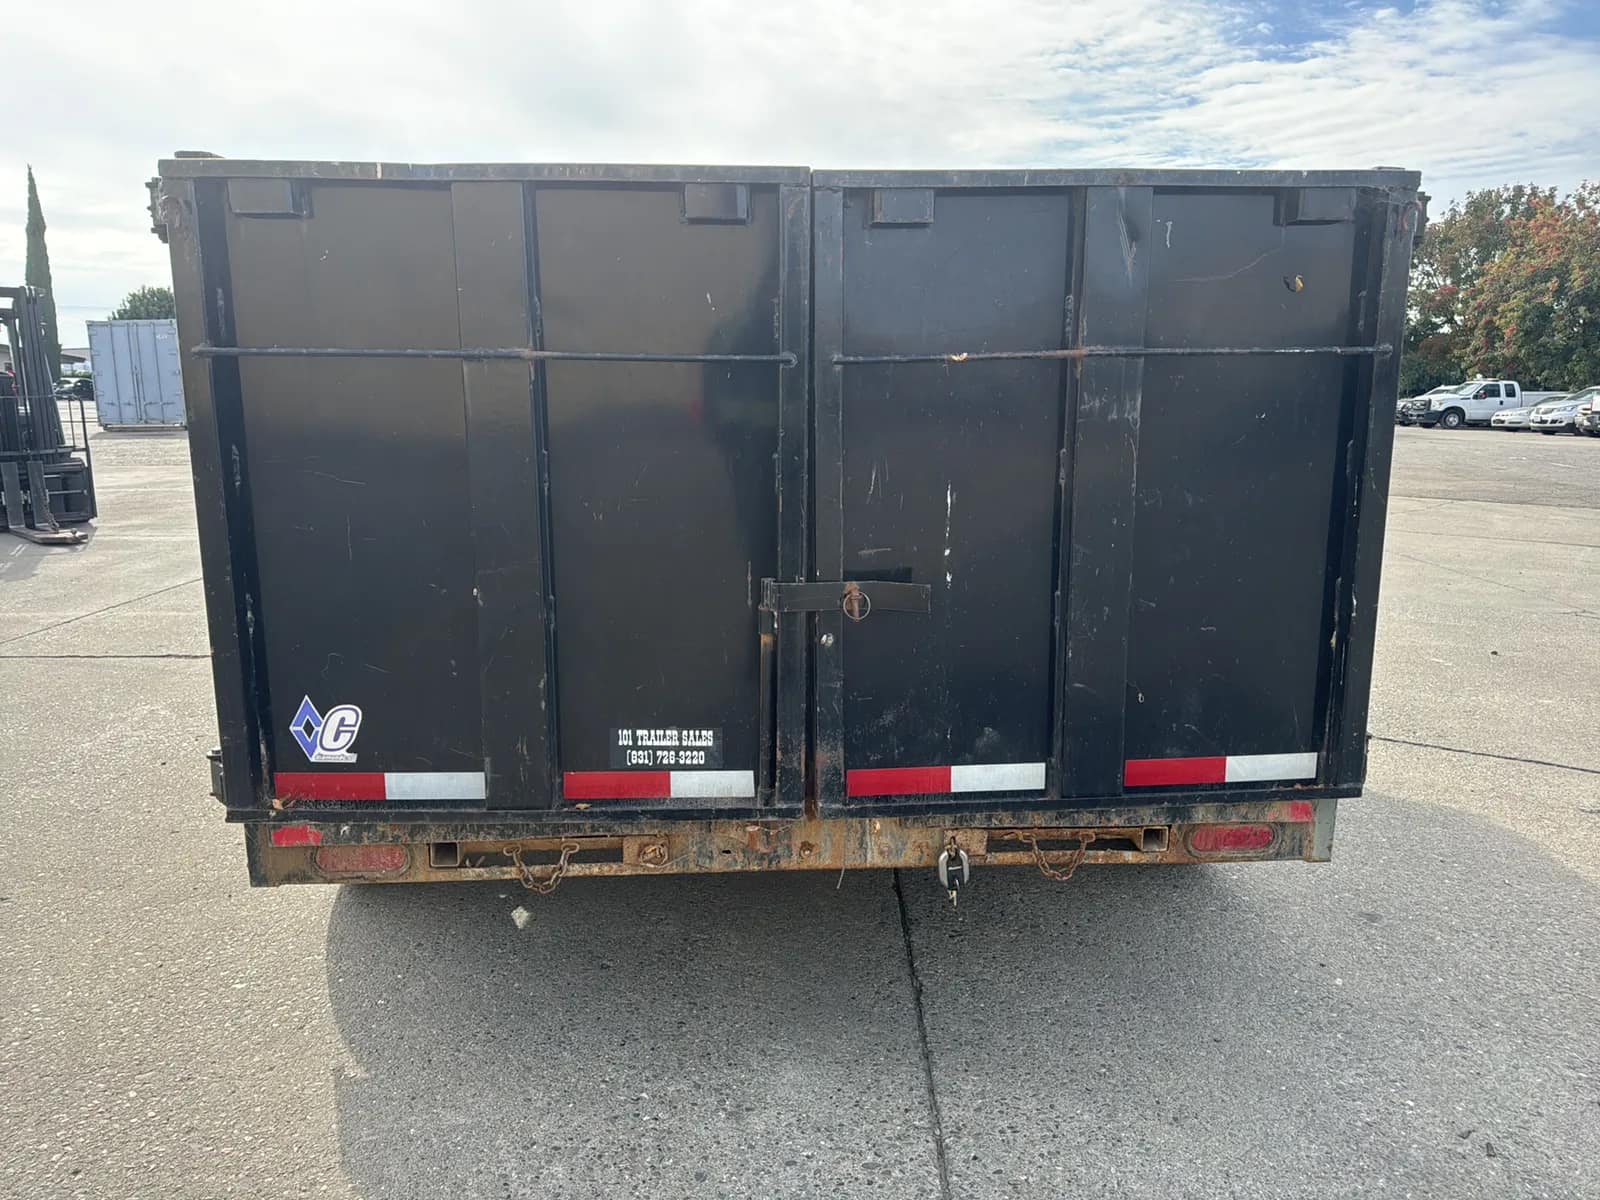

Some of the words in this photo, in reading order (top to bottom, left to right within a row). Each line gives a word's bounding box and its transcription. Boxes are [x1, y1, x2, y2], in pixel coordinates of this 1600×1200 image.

[618, 729, 633, 746] 101
[636, 729, 680, 746] TRAILER
[682, 730, 714, 747] SALES
